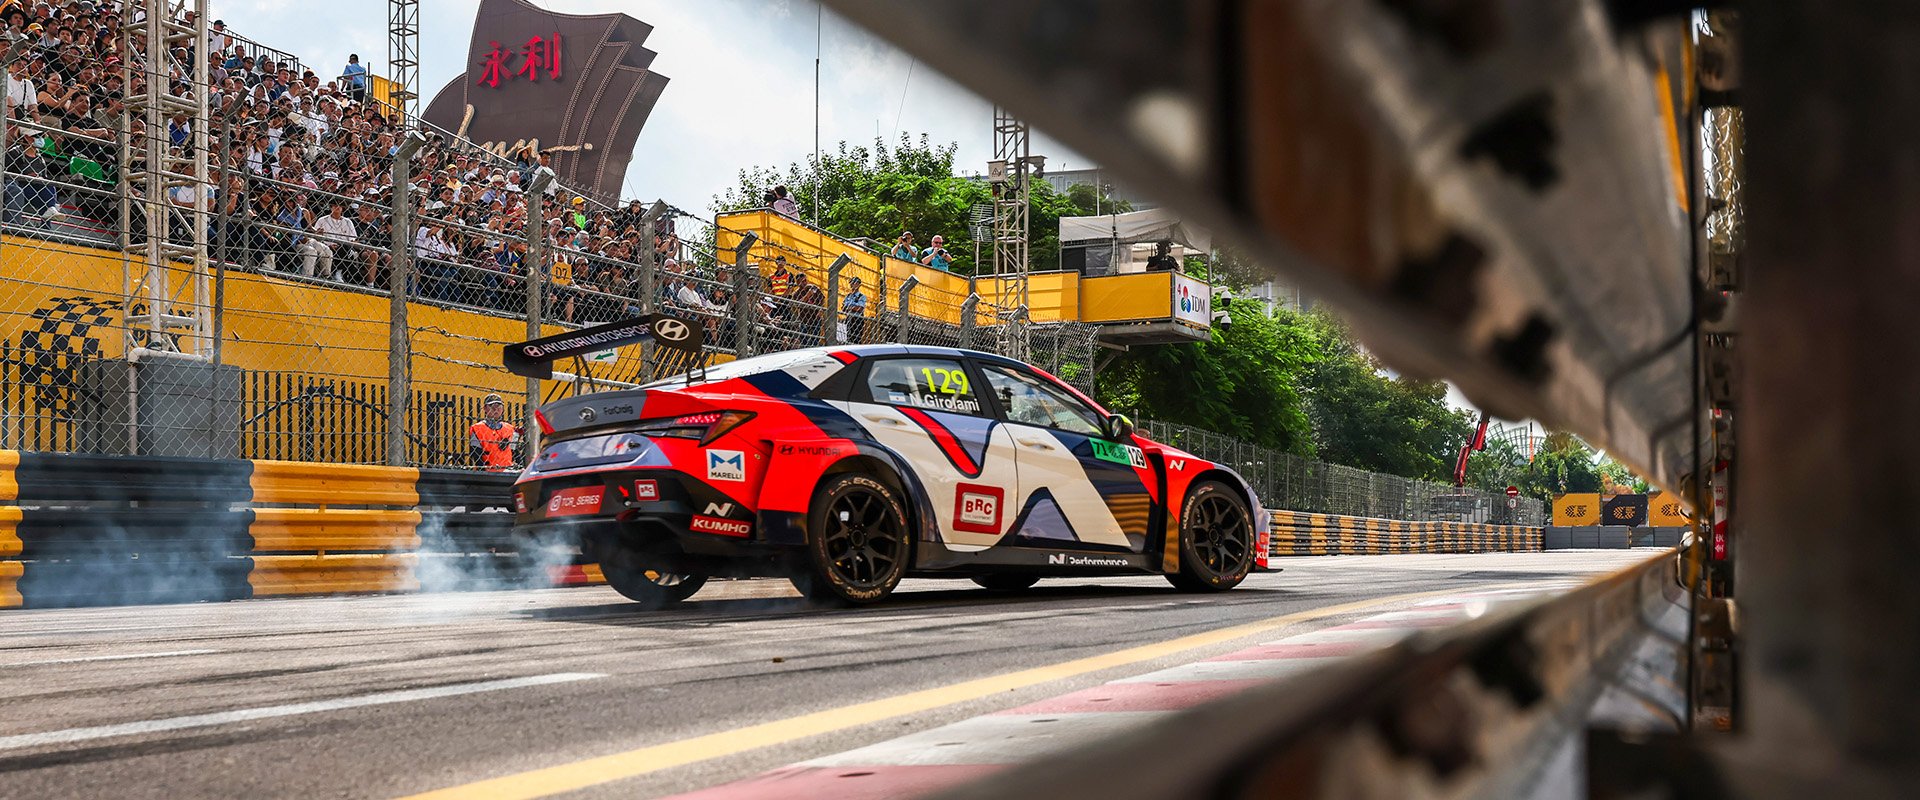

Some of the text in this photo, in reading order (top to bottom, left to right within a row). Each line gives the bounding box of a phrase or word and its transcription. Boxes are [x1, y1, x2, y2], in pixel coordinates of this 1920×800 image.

[476, 32, 562, 88] 永利
[1191, 295, 1205, 314] TDM
[542, 336, 592, 354] HYUNDAI
[921, 367, 969, 395] 129
[798, 446, 842, 457] HYUNDAI
[1092, 441, 1109, 457] 71
[1127, 447, 1146, 467] 129
[710, 471, 743, 480] MARELLI
[561, 494, 601, 508] TCR_SERIES
[965, 498, 993, 516] BRC
[693, 518, 750, 534] KUMHO
